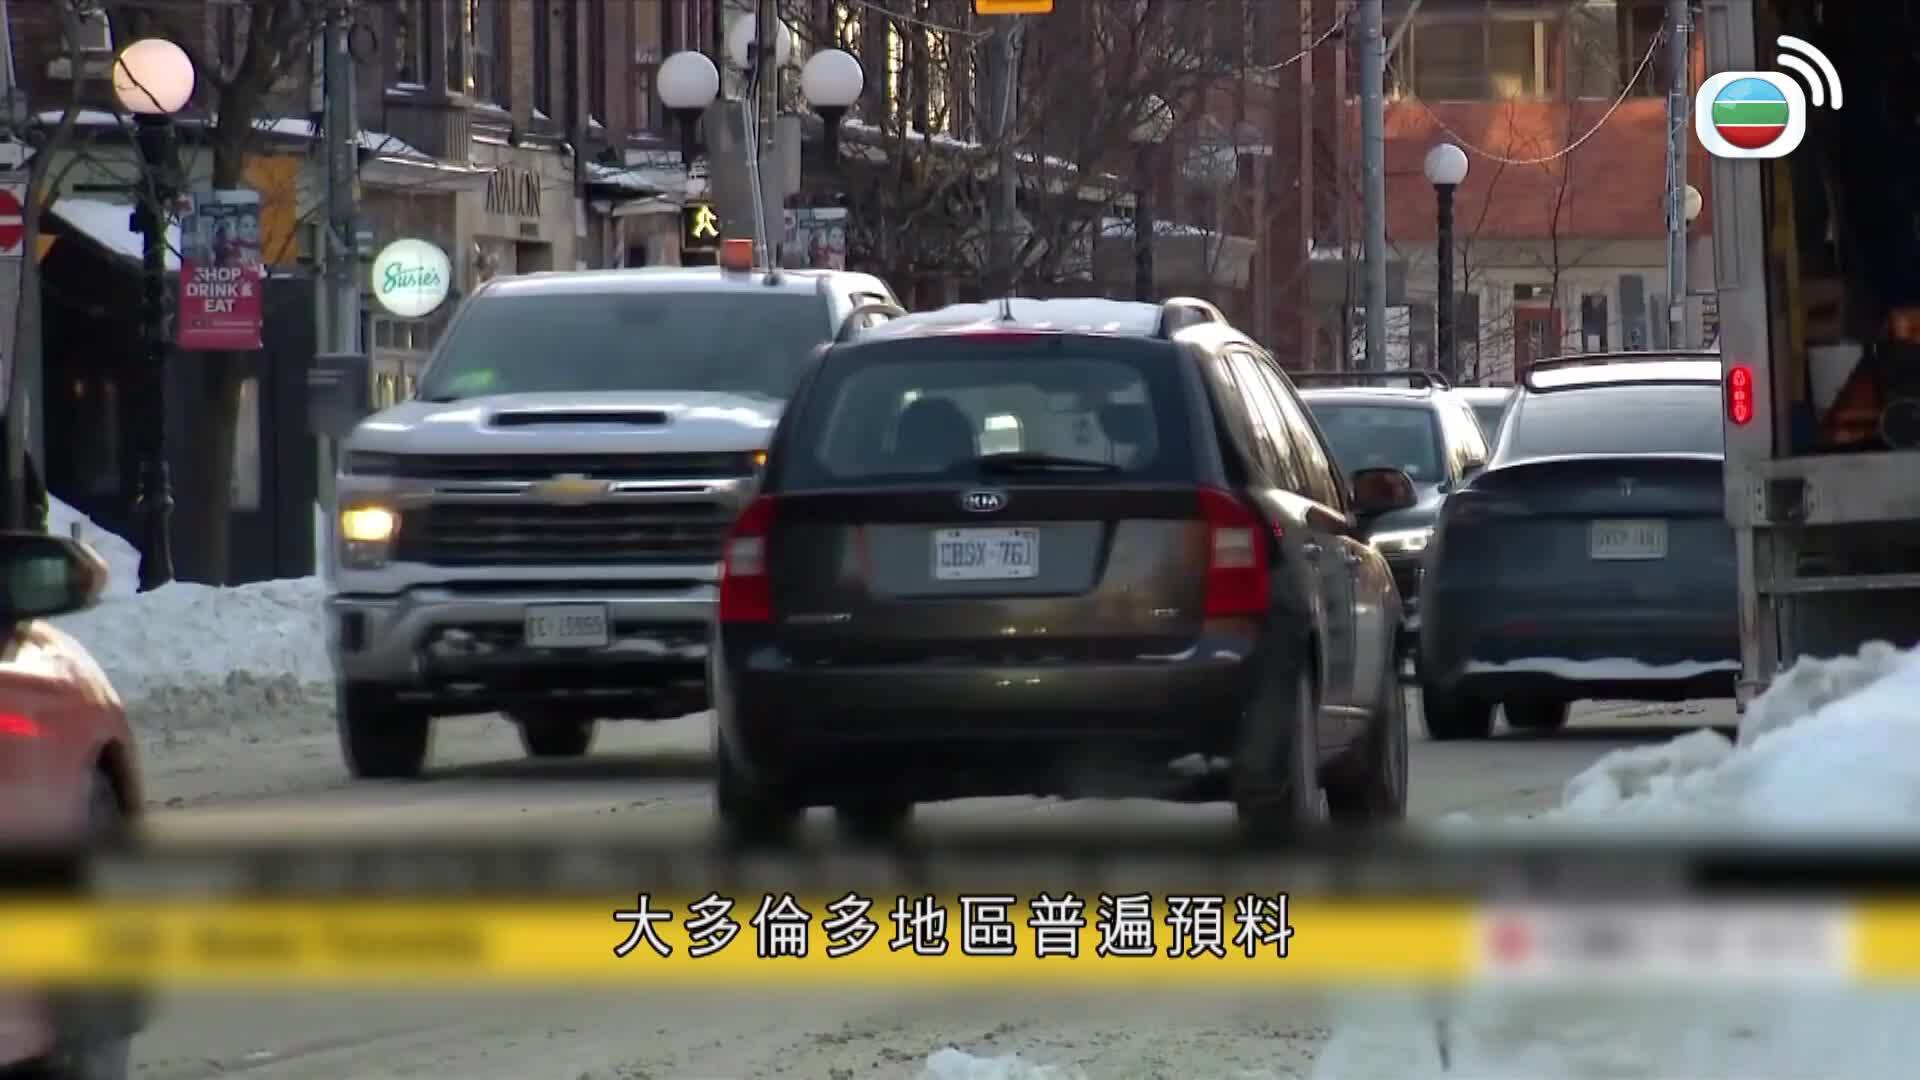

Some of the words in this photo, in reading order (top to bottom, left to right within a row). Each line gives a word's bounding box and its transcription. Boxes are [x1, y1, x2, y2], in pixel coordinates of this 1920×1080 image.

[485, 168, 541, 216] AVALON
[194, 267, 241, 281] SHOP
[383, 261, 441, 294] Susie's
[186, 283, 238, 297] DRINK
[241, 283, 252, 297] &
[204, 299, 235, 312] EAT
[967, 495, 999, 507] KIA
